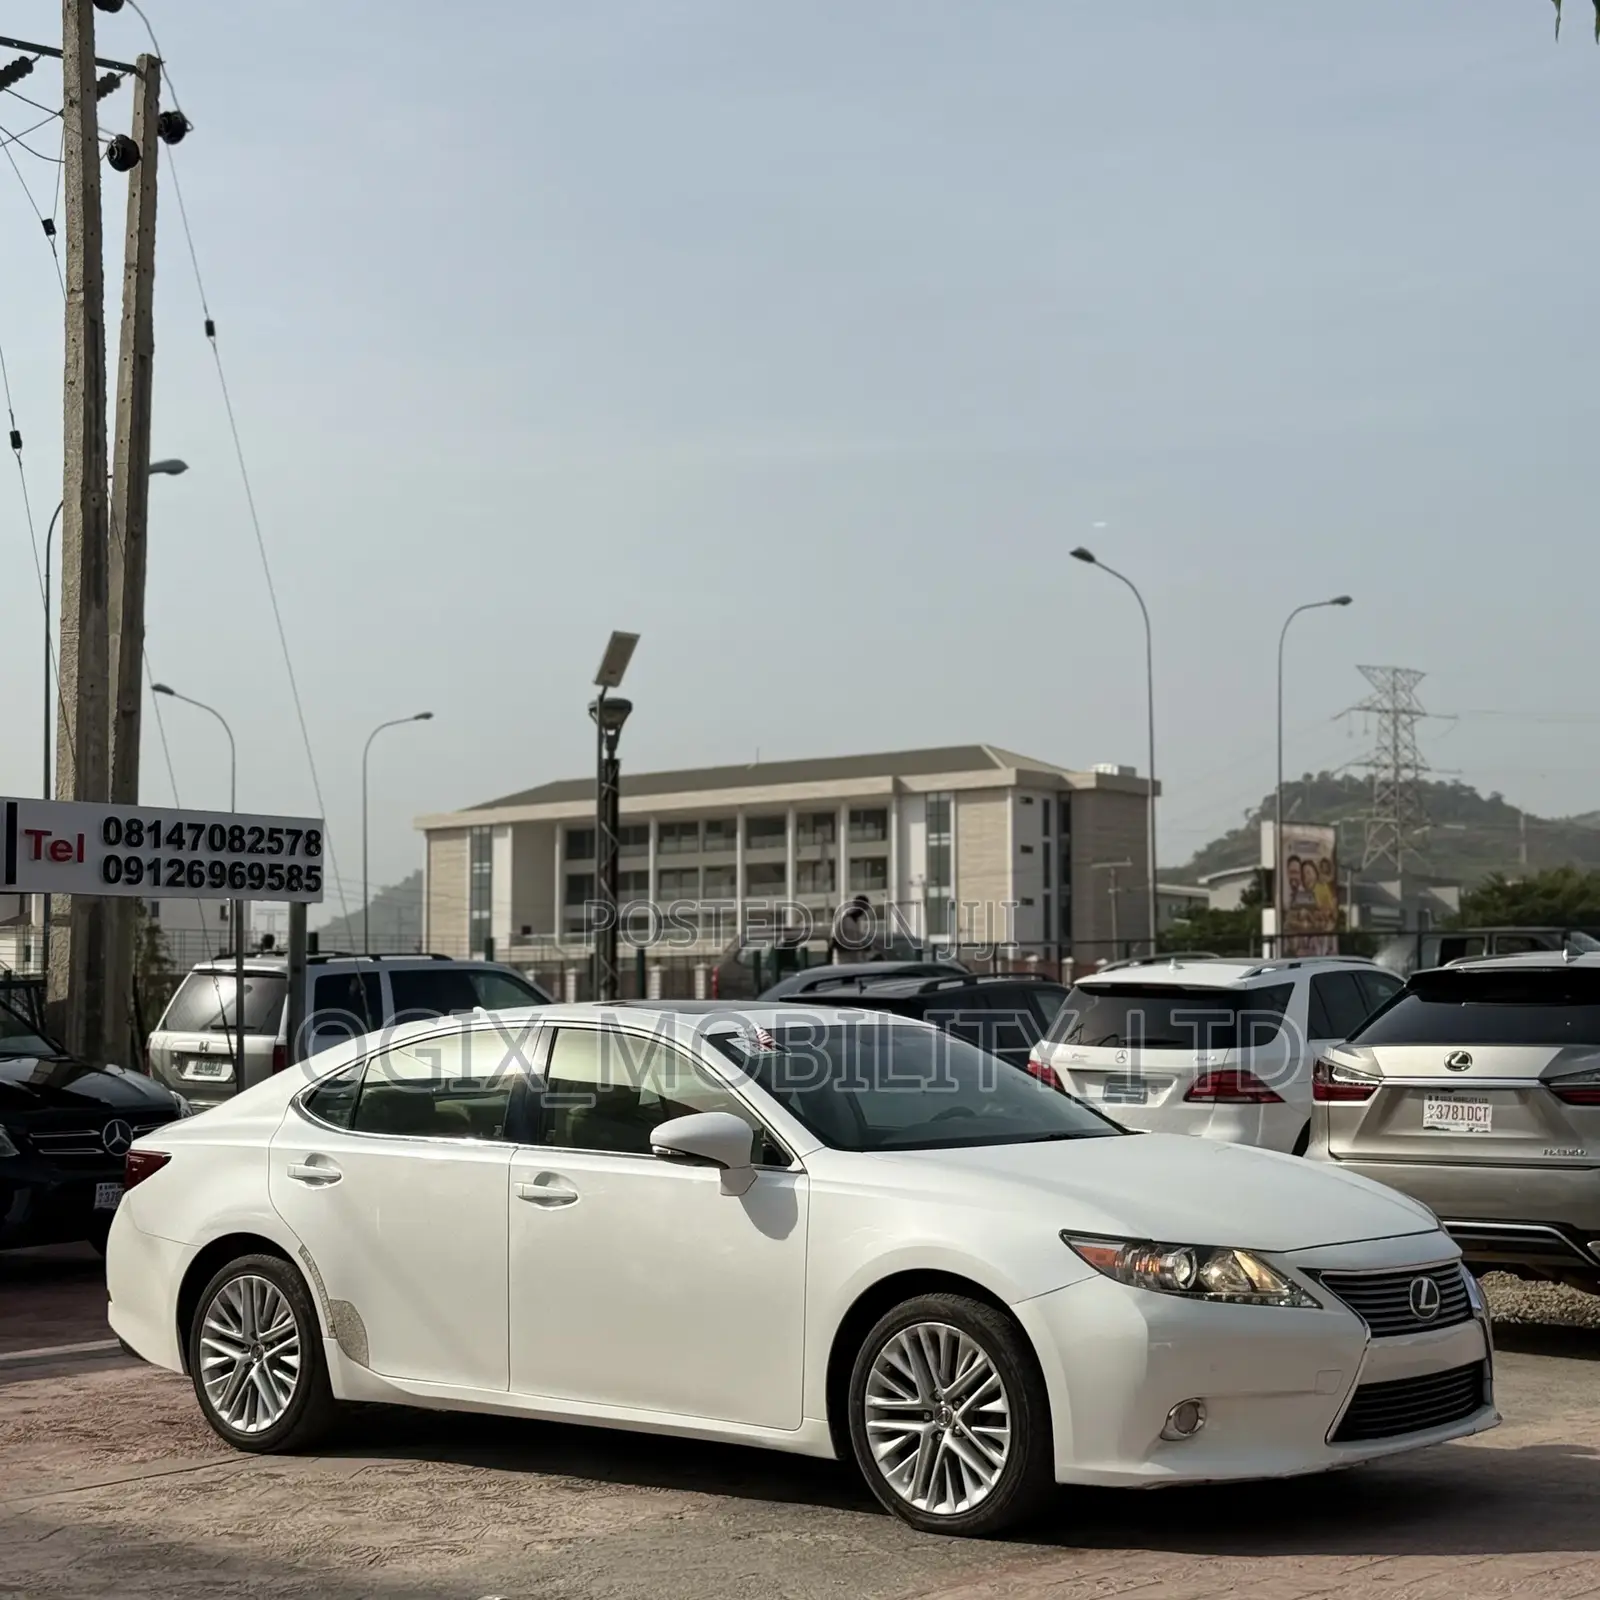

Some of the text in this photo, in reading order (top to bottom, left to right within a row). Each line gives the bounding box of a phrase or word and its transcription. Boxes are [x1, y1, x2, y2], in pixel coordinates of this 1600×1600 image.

[23, 828, 86, 864] Tel
[102, 816, 323, 858] 08147082578
[102, 854, 323, 893] 09126969585
